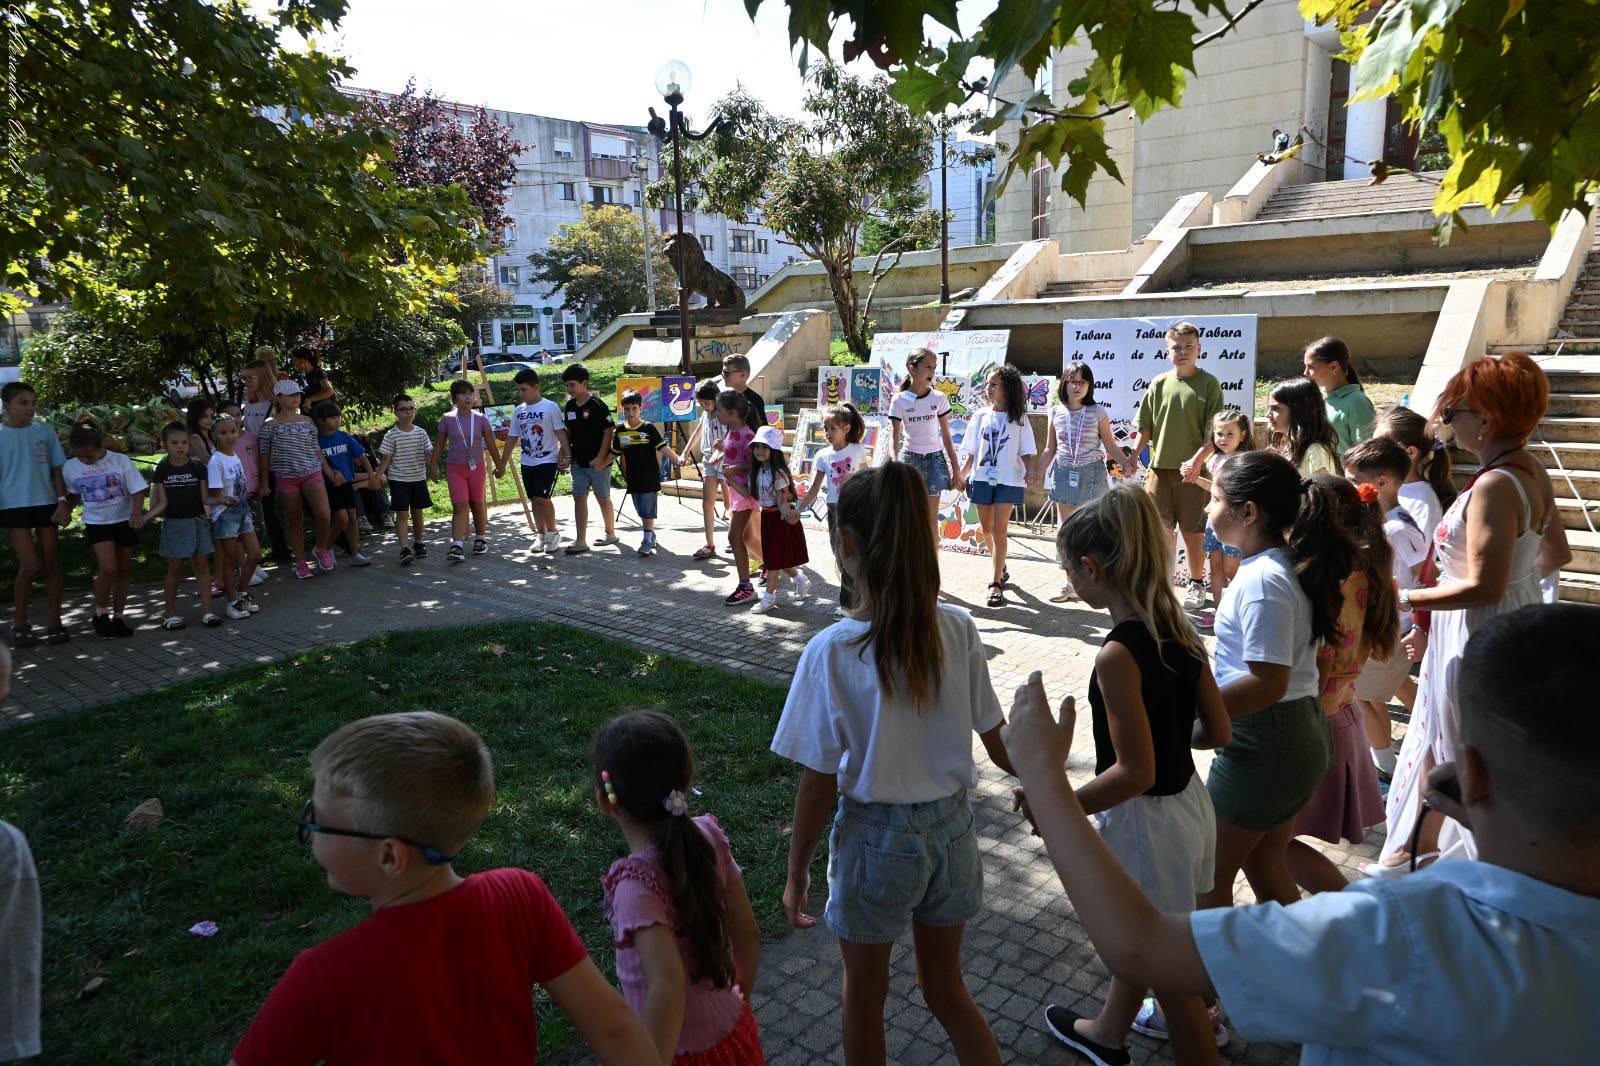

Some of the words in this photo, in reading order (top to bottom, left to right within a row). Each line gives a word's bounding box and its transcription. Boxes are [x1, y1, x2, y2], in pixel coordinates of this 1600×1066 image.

[1075, 330, 1112, 340] Tabara
[1135, 328, 1167, 339] Tabar
[1199, 327, 1242, 338] Tabara
[1071, 350, 1084, 360] de
[1093, 350, 1116, 360] Arte
[1131, 350, 1144, 360] de
[1154, 350, 1168, 360] Ar
[1218, 349, 1246, 360] Arte
